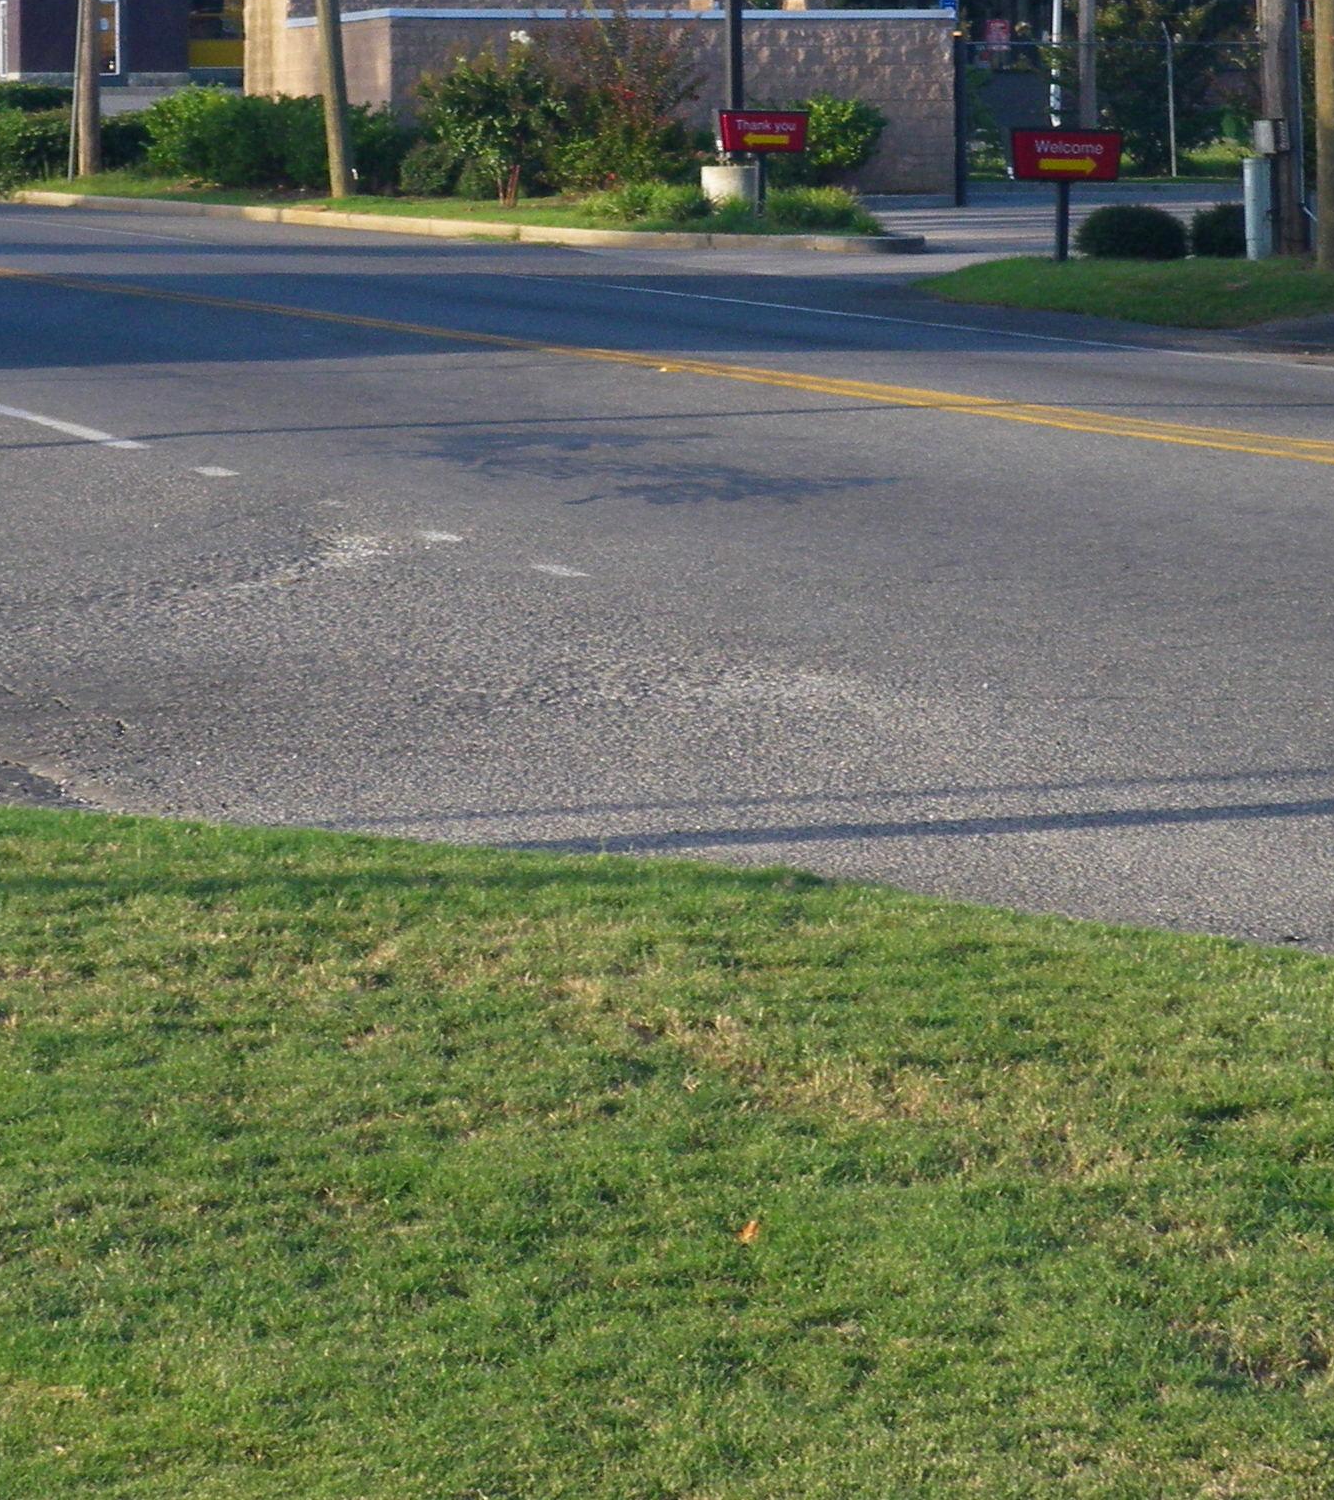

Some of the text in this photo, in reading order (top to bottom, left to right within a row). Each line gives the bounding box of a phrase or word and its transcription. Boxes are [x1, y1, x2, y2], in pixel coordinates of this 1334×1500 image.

[735, 119, 796, 133] Thank you
[1034, 139, 1104, 155] Welcome
